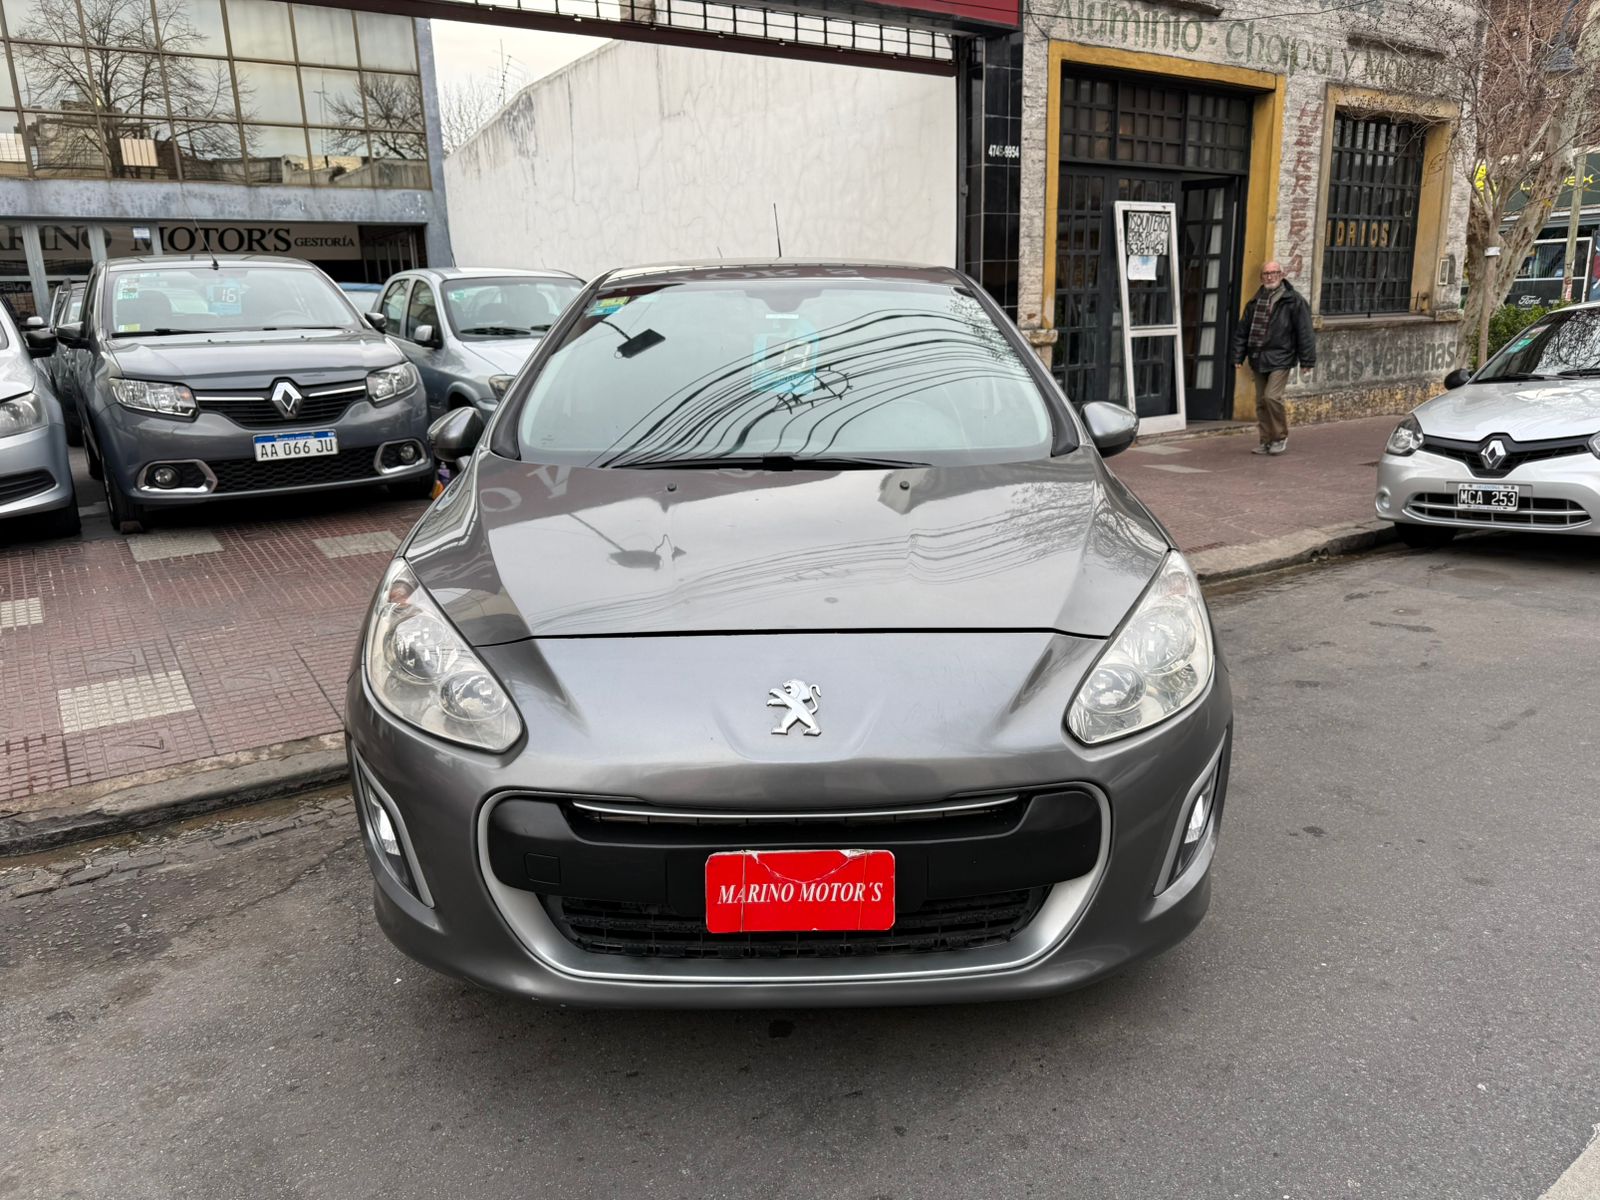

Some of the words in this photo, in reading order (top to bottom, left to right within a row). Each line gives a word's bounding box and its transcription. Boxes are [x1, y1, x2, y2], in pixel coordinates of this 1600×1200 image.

[261, 444, 279, 459] AA
[283, 441, 311, 456] 066
[316, 438, 333, 453] JU
[1460, 490, 1483, 504] MCA
[1491, 491, 1516, 506] 253
[717, 883, 795, 905] MARINO
